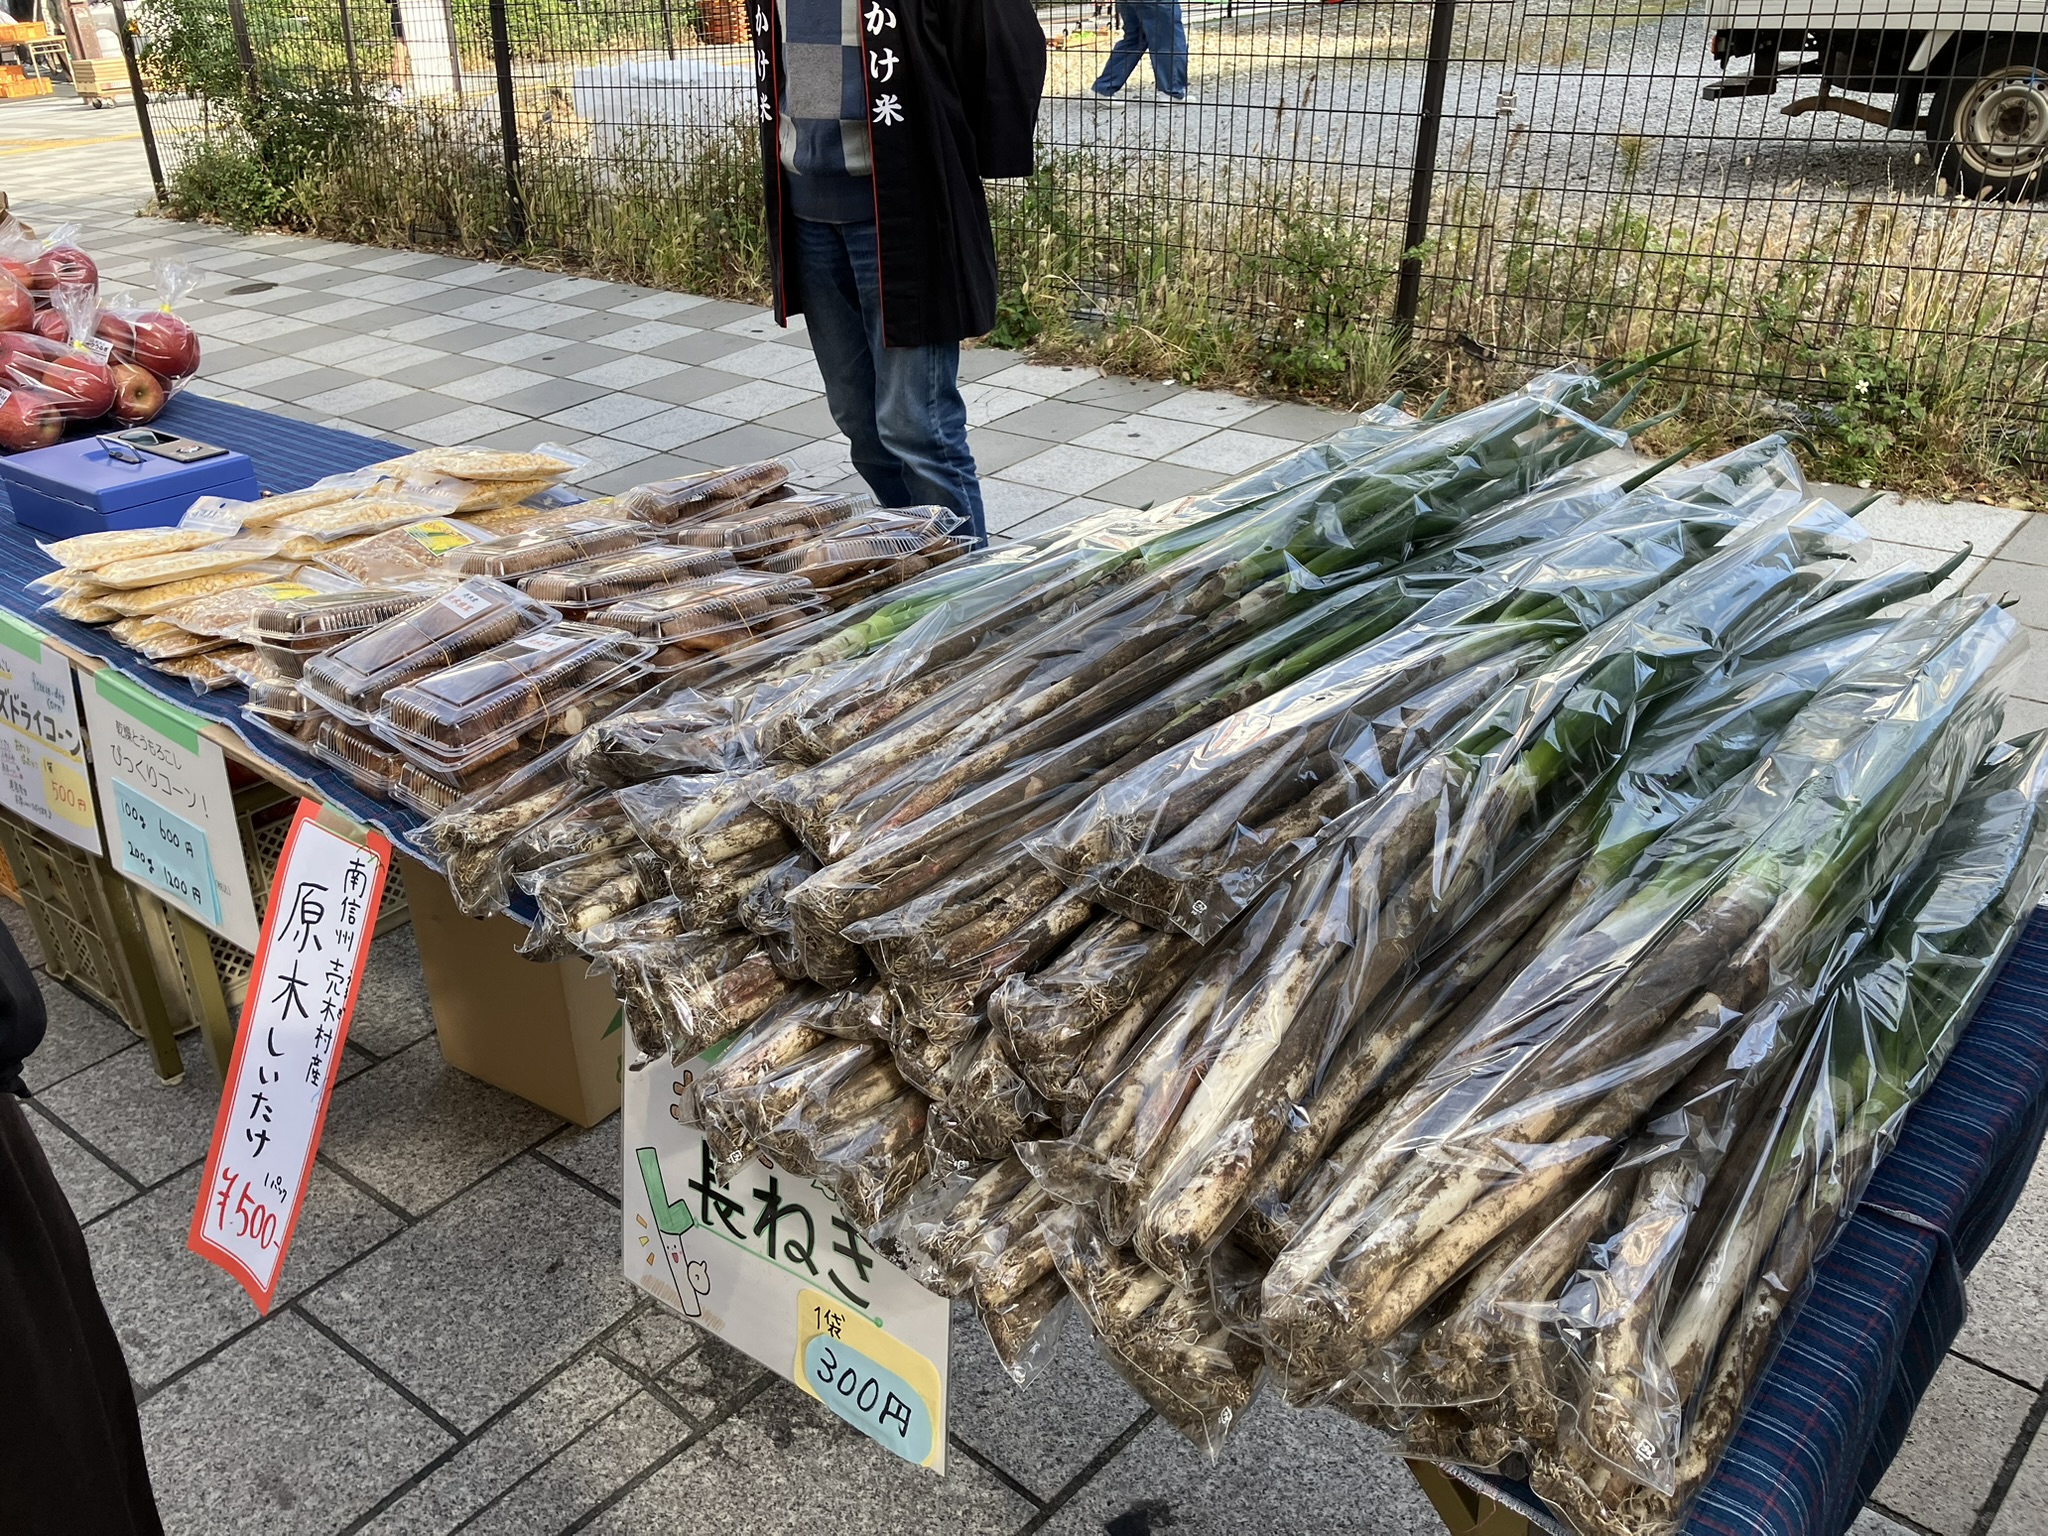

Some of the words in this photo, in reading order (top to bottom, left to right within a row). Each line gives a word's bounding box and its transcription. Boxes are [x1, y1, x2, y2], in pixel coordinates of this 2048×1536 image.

[863, 0, 905, 127] かけ米
[115, 719, 182, 771] 乾燥とうもろこし
[51, 780, 87, 813] 500円
[120, 798, 147, 830] 100g
[158, 818, 194, 858] 600円
[128, 840, 155, 874] 200g
[163, 866, 202, 905] 1200円
[246, 881, 329, 1159] 原木しいたけ
[813, 1306, 846, 1340] 1袋
[816, 1346, 912, 1438] 300円
